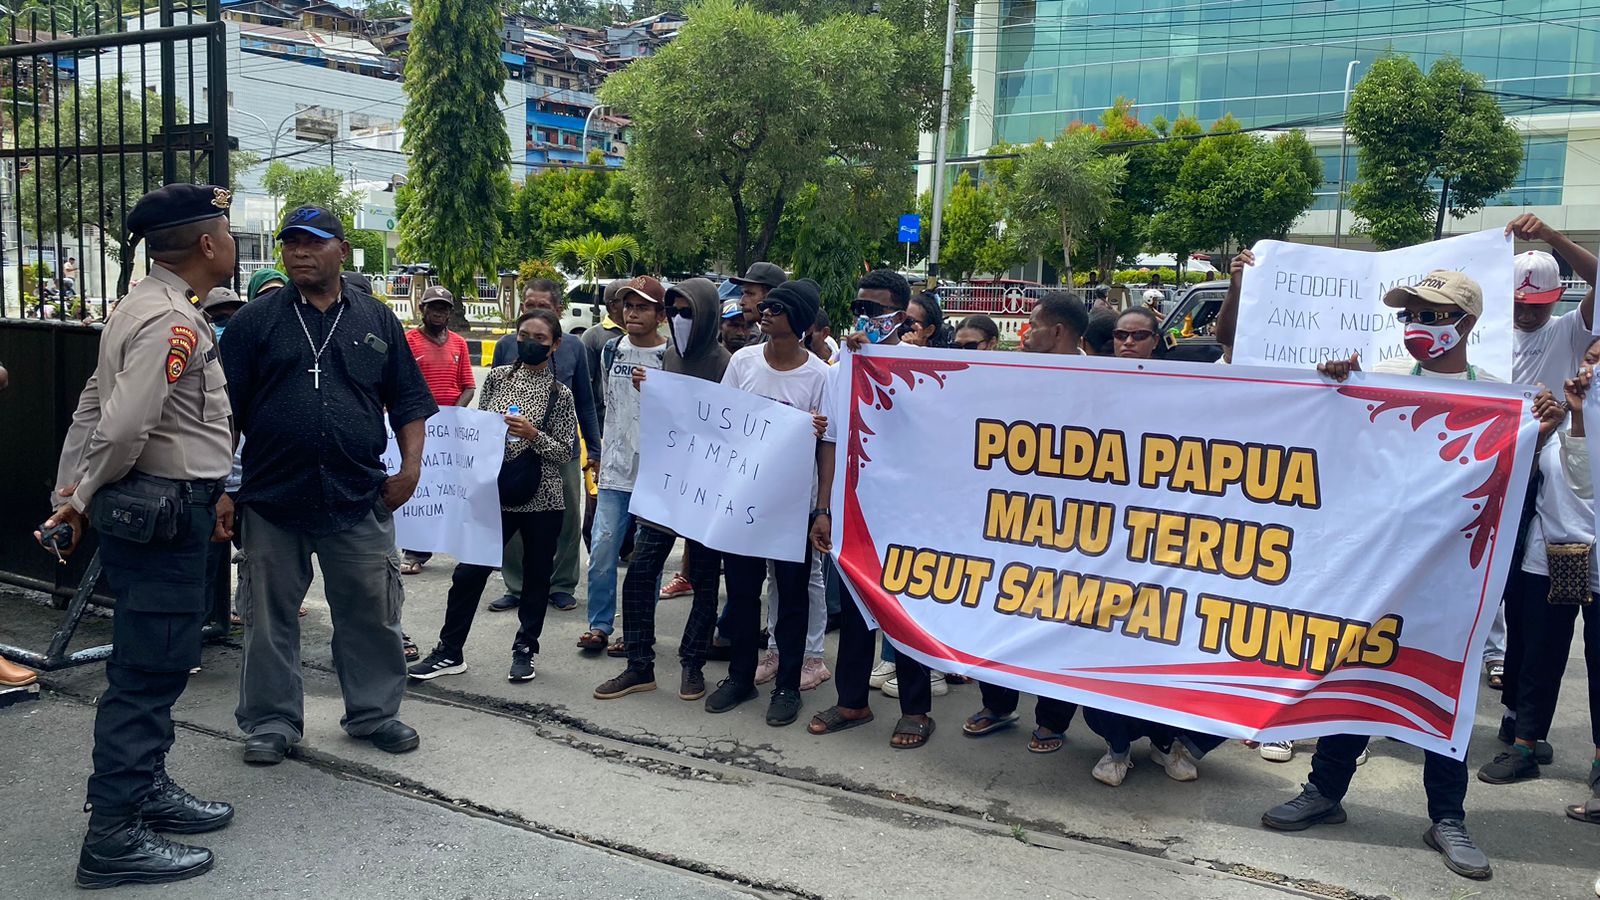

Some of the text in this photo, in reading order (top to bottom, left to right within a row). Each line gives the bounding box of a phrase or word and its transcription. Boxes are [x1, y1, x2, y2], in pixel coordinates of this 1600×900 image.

[1274, 271, 1363, 300] PEODOFIL
[1267, 307, 1396, 333] ANAK MUDA
[1264, 343, 1363, 364] HANCURKAN
[424, 425, 450, 438] RGA
[697, 400, 771, 441] USUT
[666, 430, 760, 481] SAMPAI
[974, 417, 1322, 509] POLDA PAPUA
[402, 503, 444, 517] HUKUM
[663, 473, 756, 525] TUNTAS
[983, 489, 1294, 586] MAJU TERUS
[880, 543, 1404, 676] USUT SAMPAI TUNTAS
